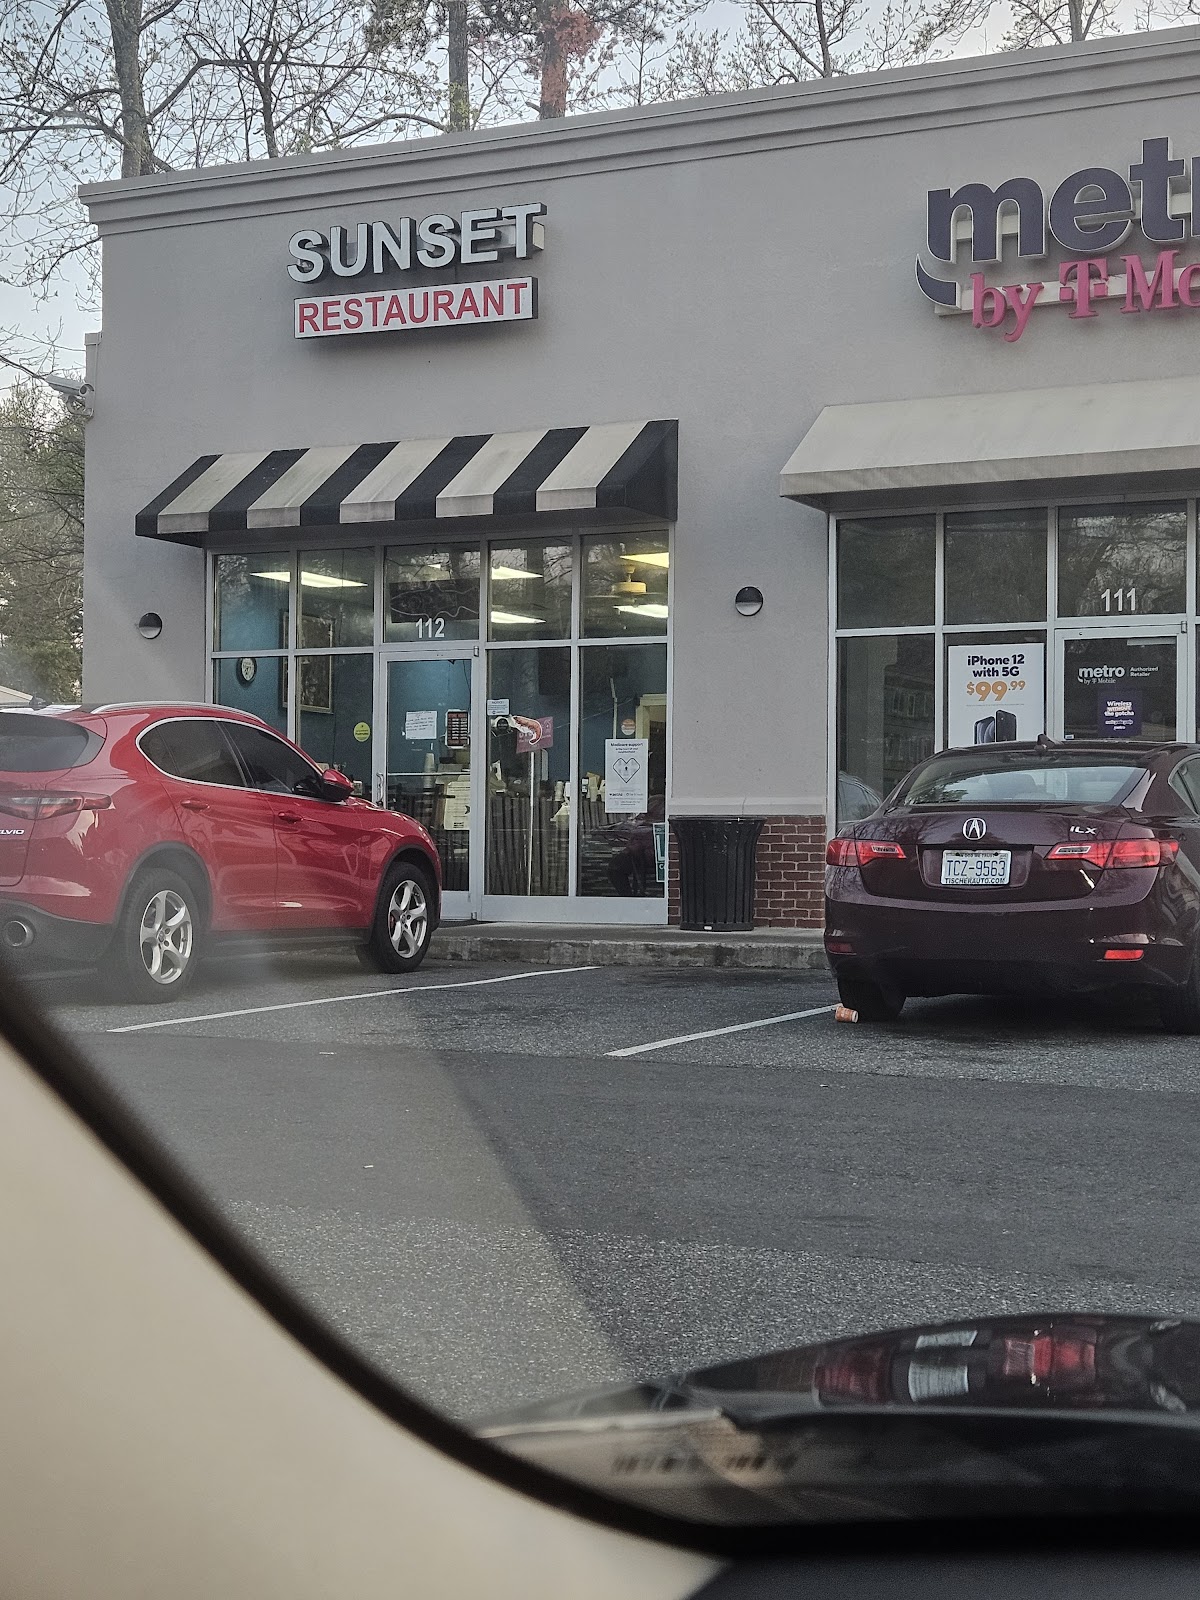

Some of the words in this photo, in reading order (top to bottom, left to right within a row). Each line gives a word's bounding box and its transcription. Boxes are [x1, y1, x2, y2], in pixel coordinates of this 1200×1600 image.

[287, 202, 545, 283] SUNSET
[298, 282, 528, 333] RESTAURANT
[970, 272, 1044, 342] by
[1100, 588, 1136, 611] 111
[415, 618, 445, 638] 112
[967, 655, 1010, 666] iPhone
[1011, 653, 1025, 665] 12
[972, 666, 1000, 678] with
[1001, 666, 1020, 677] 5G
[1078, 665, 1125, 678] metro
[966, 680, 1026, 701] $99.99
[1070, 825, 1098, 835] ILX
[946, 860, 1006, 877] TCZ-9563
